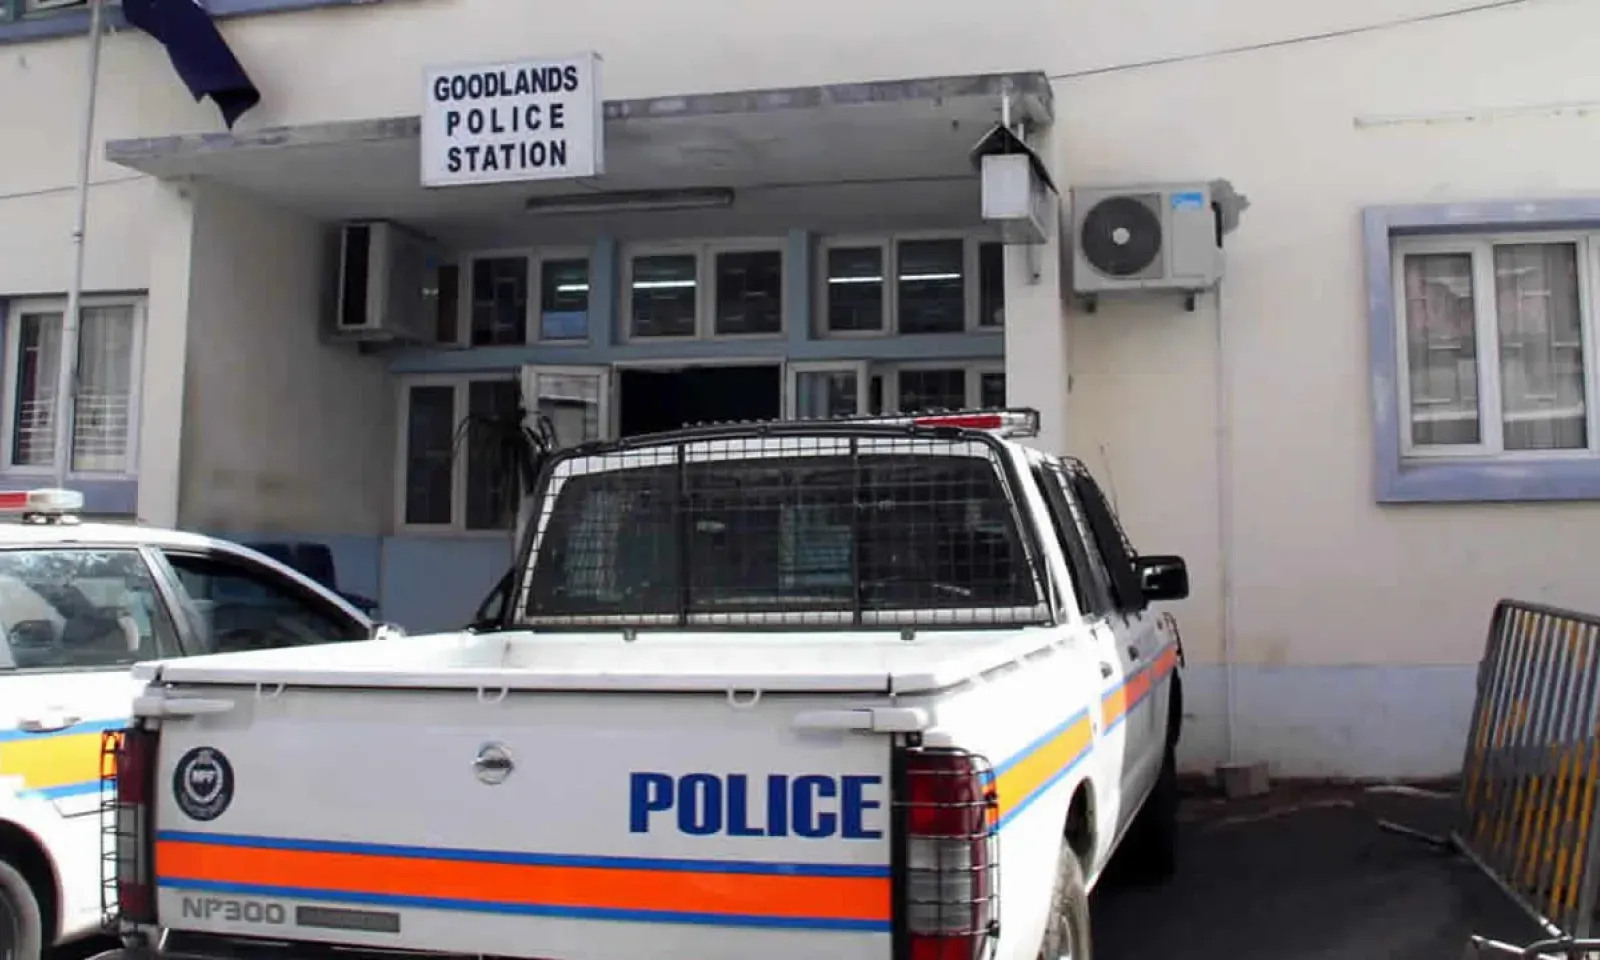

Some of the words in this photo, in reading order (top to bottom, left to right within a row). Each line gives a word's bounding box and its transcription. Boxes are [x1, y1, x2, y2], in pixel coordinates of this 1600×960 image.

[434, 65, 578, 101] GOODLANDS
[447, 103, 564, 136] POLICE
[447, 139, 566, 173] STATION
[629, 772, 882, 839] POLICE
[182, 897, 285, 924] NP300
